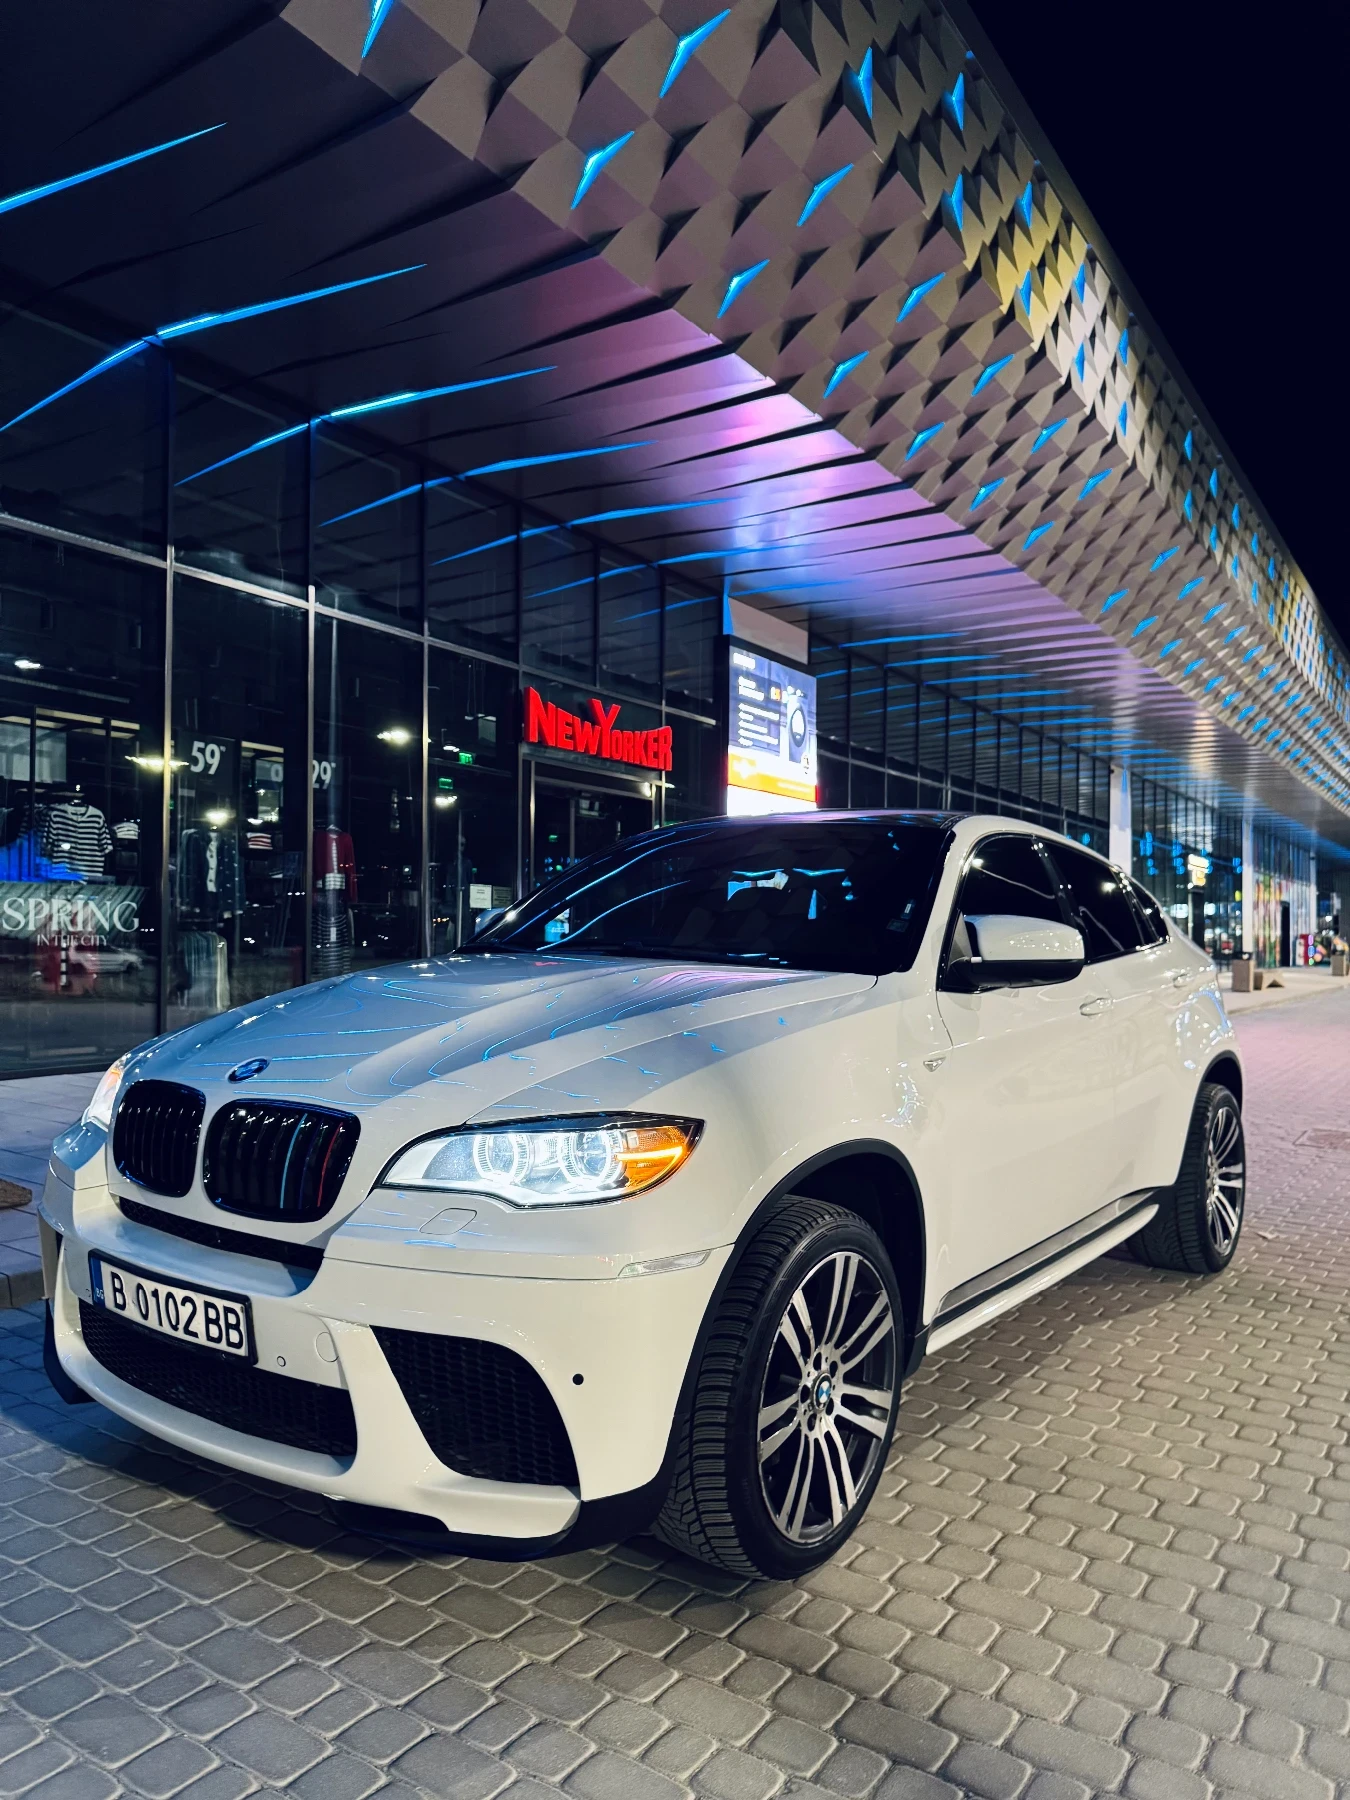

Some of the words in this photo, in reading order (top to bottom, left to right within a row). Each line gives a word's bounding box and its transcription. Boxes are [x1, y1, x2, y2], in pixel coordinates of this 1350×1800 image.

[2, 897, 140, 932] SPRING
[37, 934, 50, 947] IN
[54, 934, 78, 947] THE
[81, 934, 108, 947] CITY
[111, 1271, 126, 1311] B
[137, 1283, 199, 1339] 0102
[204, 1300, 244, 1349] BB
